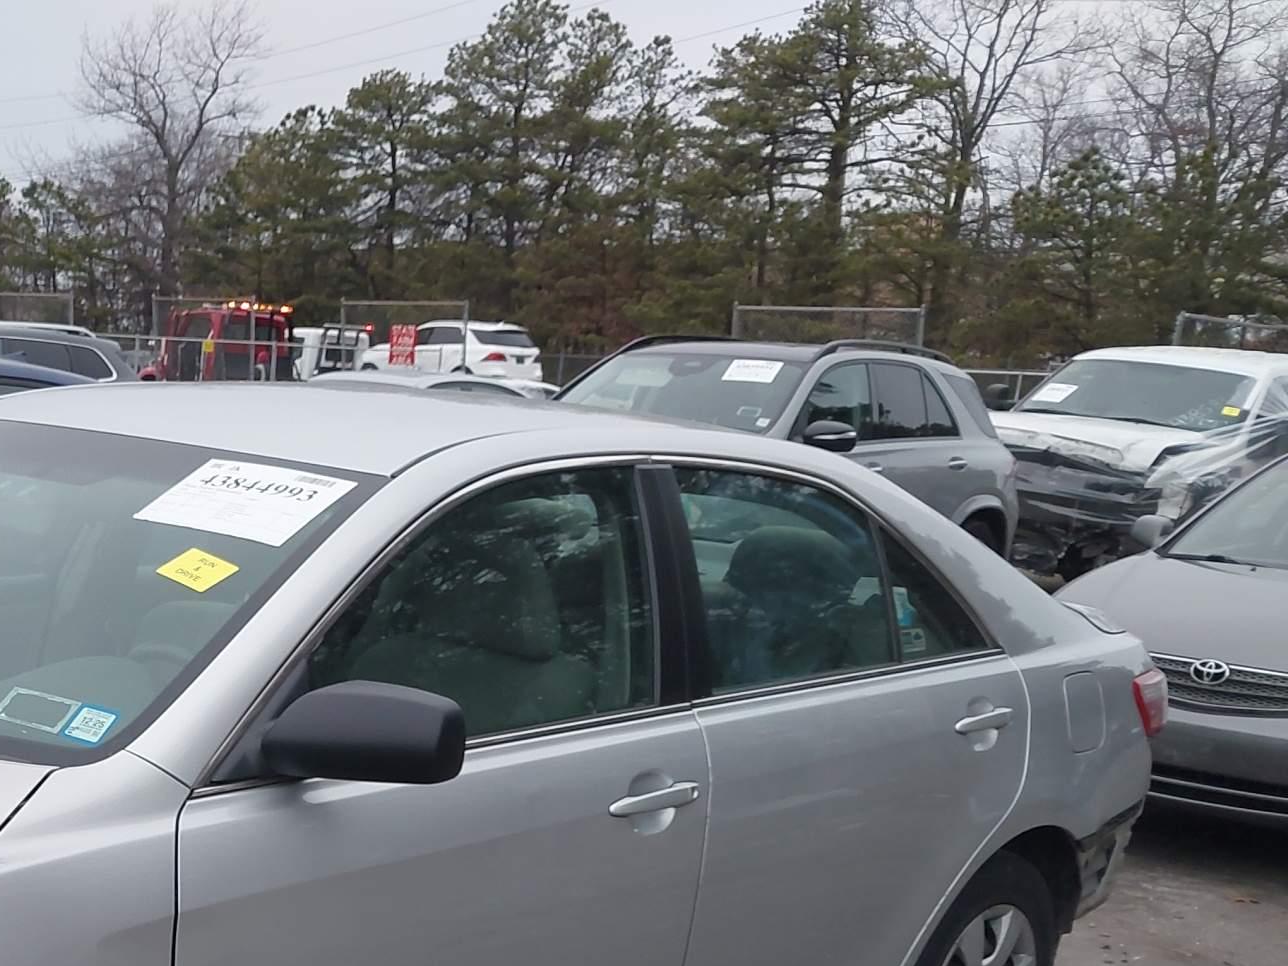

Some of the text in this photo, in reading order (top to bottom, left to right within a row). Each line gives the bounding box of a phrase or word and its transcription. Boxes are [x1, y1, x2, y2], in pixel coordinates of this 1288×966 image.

[201, 474, 318, 502] 43844993
[199, 558, 218, 568] RUN
[175, 568, 202, 581] DRIVE
